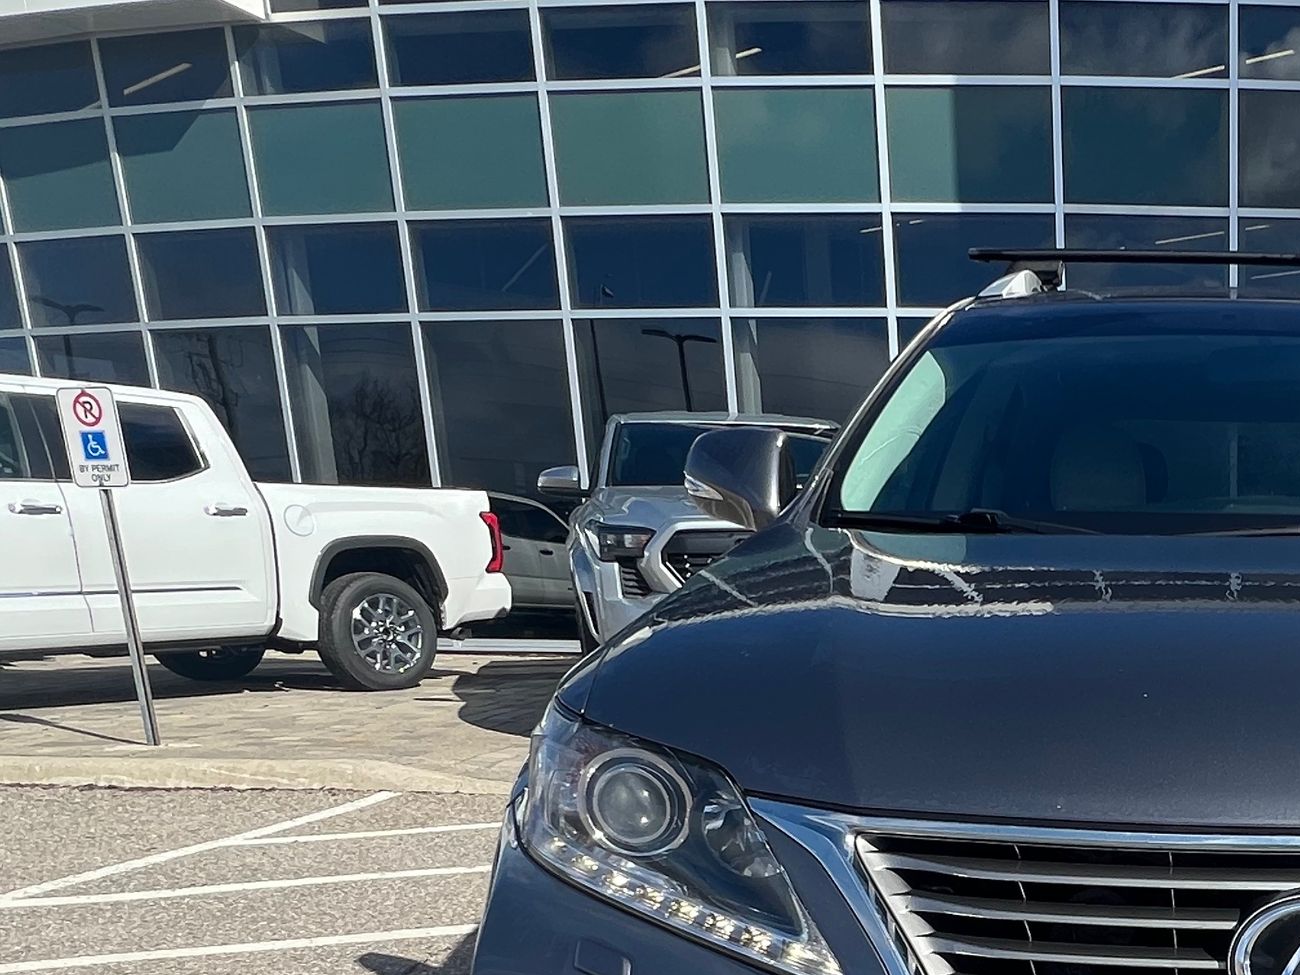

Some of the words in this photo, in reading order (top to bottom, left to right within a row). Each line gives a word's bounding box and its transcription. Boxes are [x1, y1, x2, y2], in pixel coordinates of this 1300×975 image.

[79, 465, 89, 474] BY
[91, 464, 120, 473] PERMIT
[91, 473, 112, 483] ONLY
